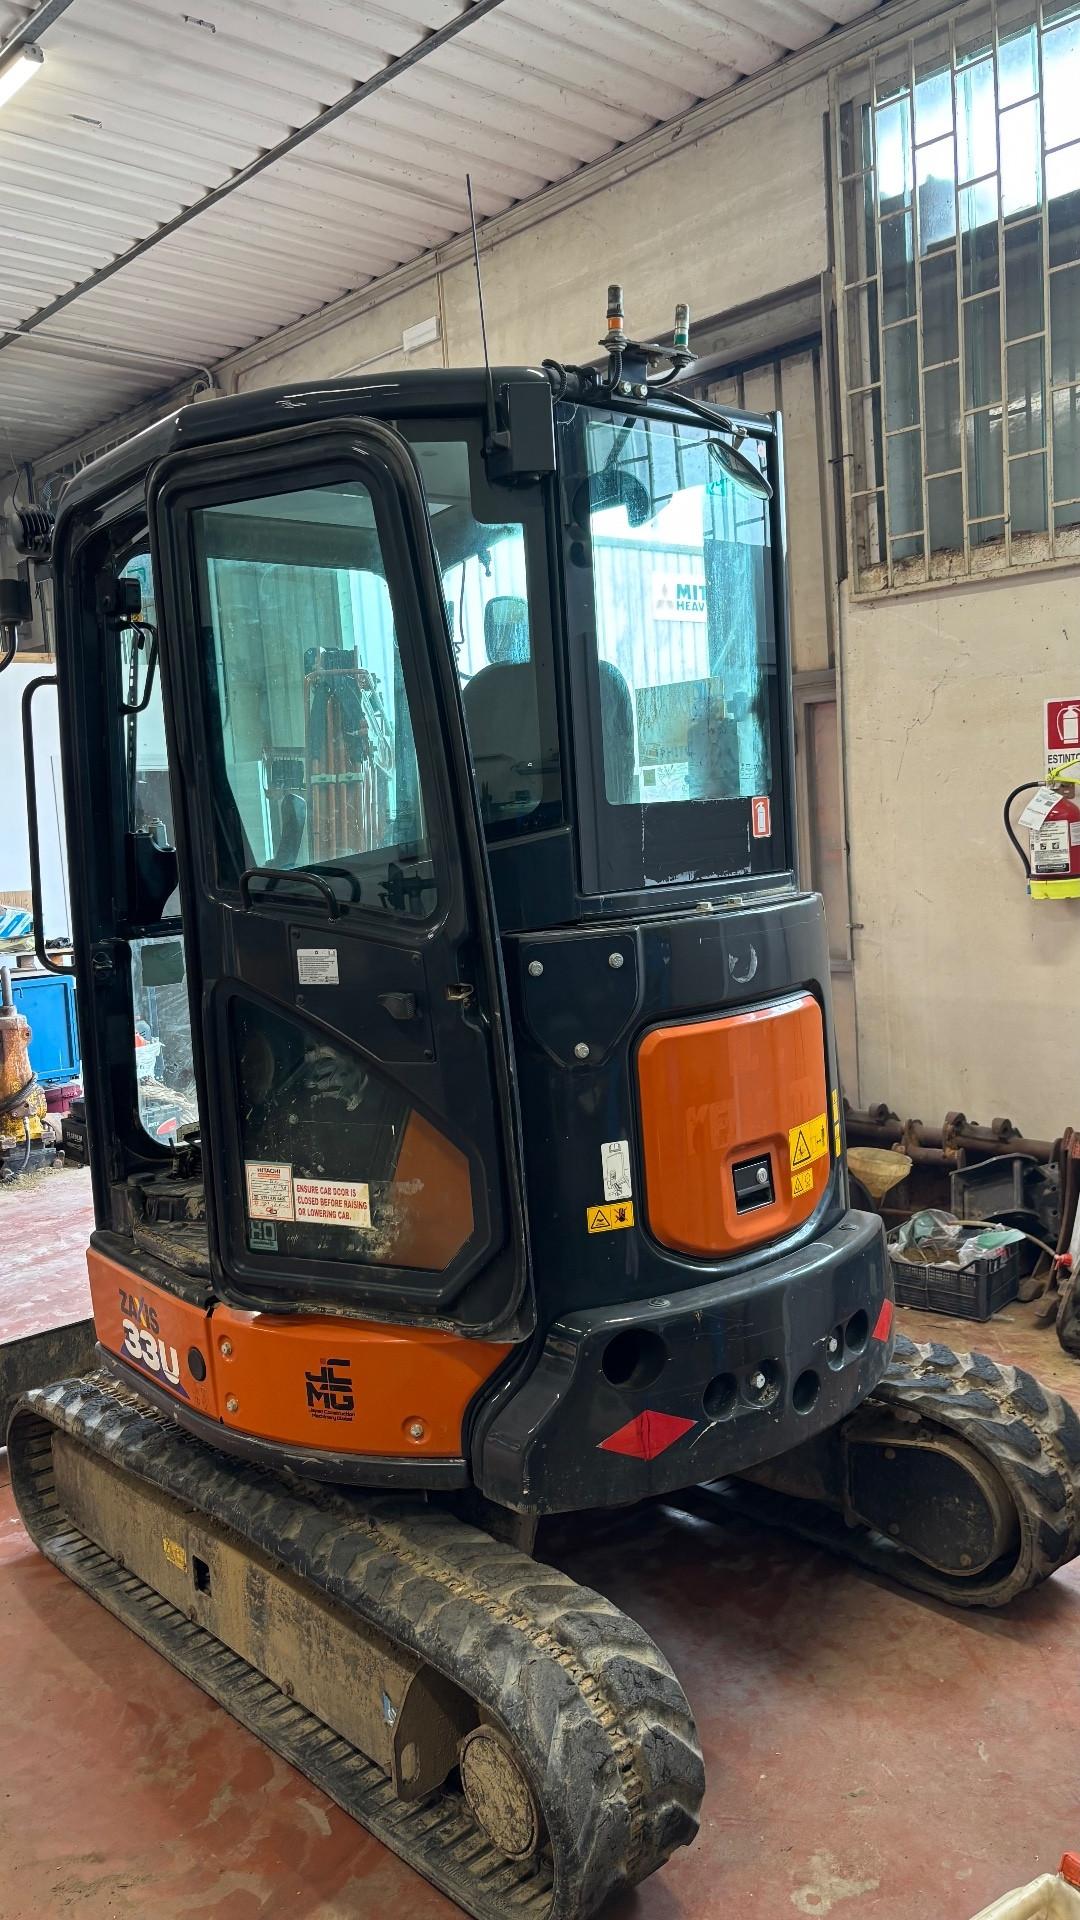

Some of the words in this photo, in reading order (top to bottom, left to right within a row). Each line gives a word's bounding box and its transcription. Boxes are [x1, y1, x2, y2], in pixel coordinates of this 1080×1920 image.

[296, 1184, 319, 1194] ENSURE
[319, 1186, 332, 1196] CAB
[332, 1187, 350, 1197] DOOR
[350, 1188, 357, 1198] IS
[297, 1196, 319, 1206] CLOSED
[319, 1197, 343, 1208] BEFORE
[343, 1199, 368, 1210] RAISING
[298, 1208, 307, 1216] OR
[307, 1209, 337, 1219] LOWERING
[337, 1211, 352, 1220] CAB.
[118, 1287, 160, 1335] ZAXIS
[122, 1318, 180, 1385] 33U
